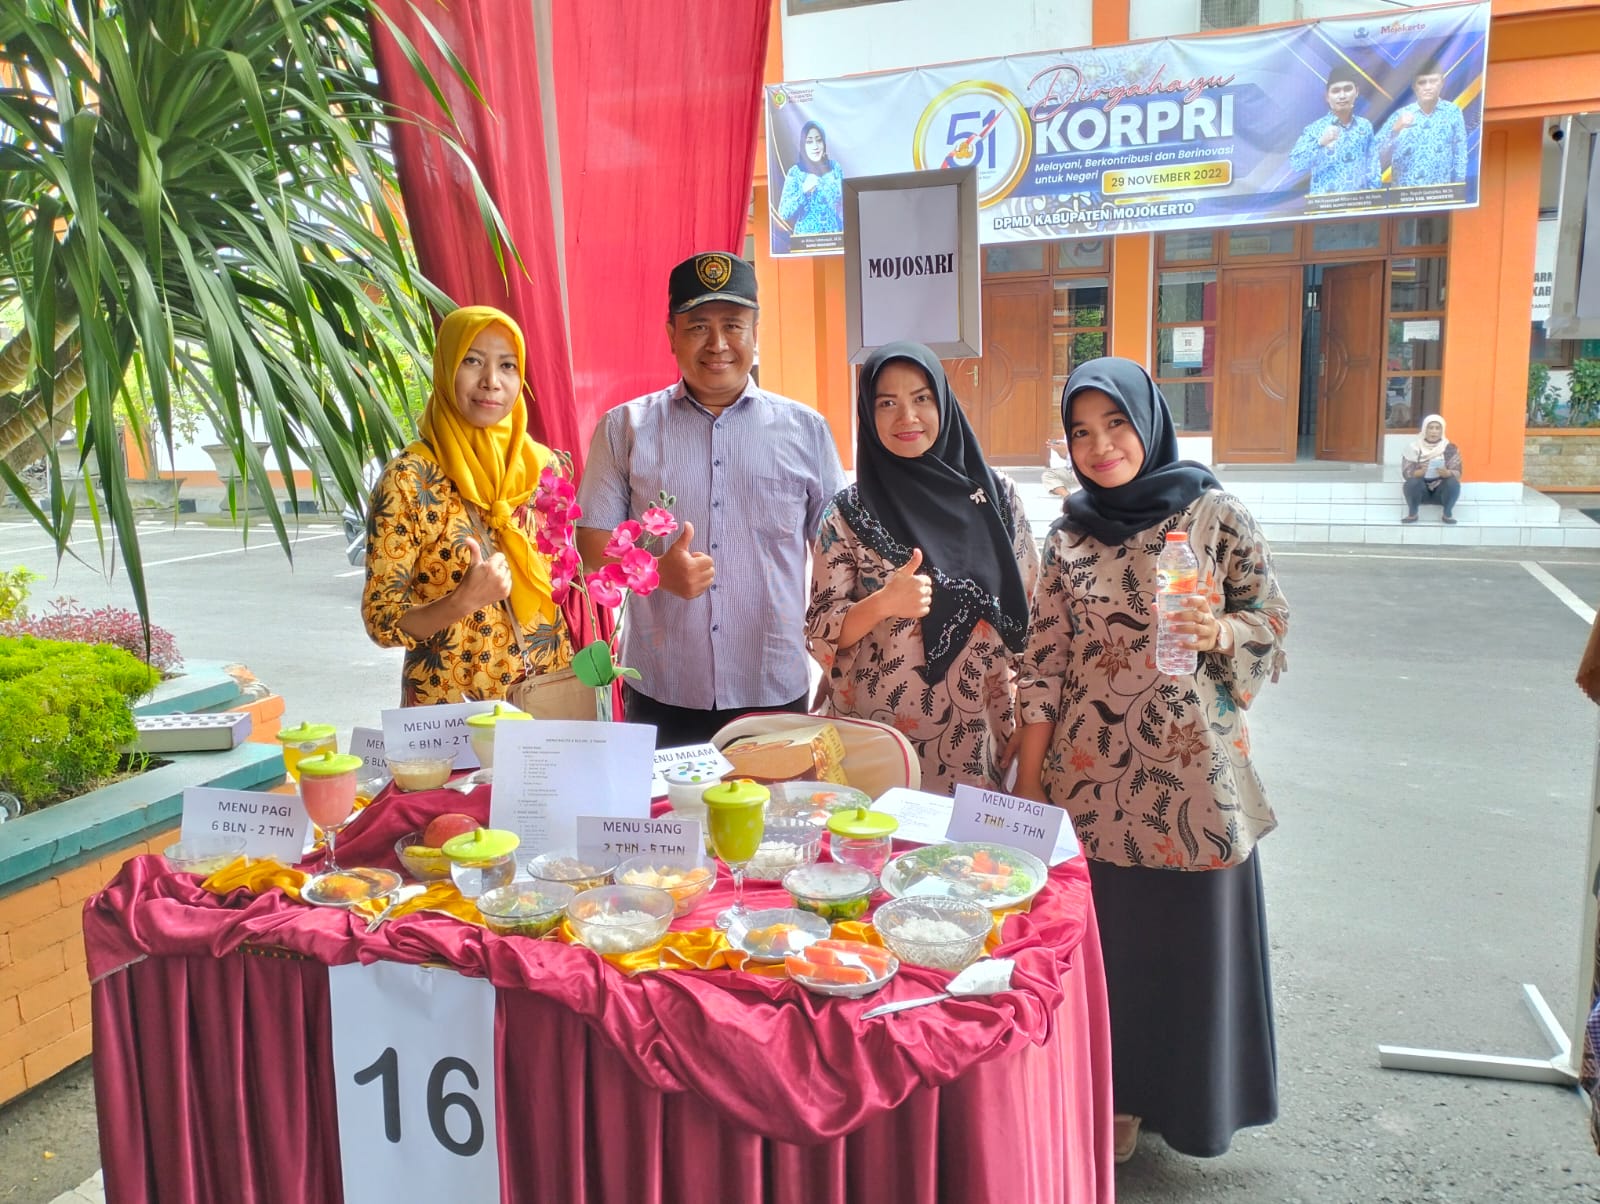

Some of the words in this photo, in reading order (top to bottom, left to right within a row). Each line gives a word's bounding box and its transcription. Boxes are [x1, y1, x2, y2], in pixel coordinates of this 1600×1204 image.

[1027, 64, 1235, 122] Dirgahayu
[1035, 94, 1234, 155] KORPRI
[946, 109, 996, 169] 51
[1035, 159, 1082, 174] Melayani,
[1085, 154, 1153, 168] Berkontribusi
[1154, 151, 1175, 161] dan
[1178, 145, 1234, 159] Berinovasi
[1035, 174, 1063, 185] untuk
[1065, 170, 1099, 184] Negeri
[1111, 177, 1125, 188] 29
[1127, 172, 1191, 186] NOVEMBER
[1193, 168, 1222, 181] 2022
[993, 216, 1032, 230] DPMD
[1034, 209, 1111, 226] KABUPATEN
[1113, 202, 1195, 220] MOJOKERTO
[868, 253, 954, 280] MOJOSARI
[404, 721, 441, 733] MENU
[453, 736, 461, 745] 2
[364, 756, 370, 765] 6
[675, 748, 715, 760] MALAM
[218, 801, 258, 814] MENU
[261, 805, 292, 817] PAGI
[982, 792, 1015, 809] MENU
[1018, 801, 1045, 817] PAGI
[211, 820, 219, 831] 6
[223, 821, 247, 833] BLN
[258, 824, 265, 835] 2
[269, 825, 295, 838] THN
[603, 821, 640, 833] MENU
[643, 822, 682, 835] SIANG
[974, 812, 982, 823] 2
[984, 813, 1005, 828] THN
[1012, 822, 1021, 833] 5
[1023, 824, 1045, 839] THN
[616, 843, 639, 854] THN
[660, 845, 686, 856] THN
[353, 1046, 485, 1157] 16
